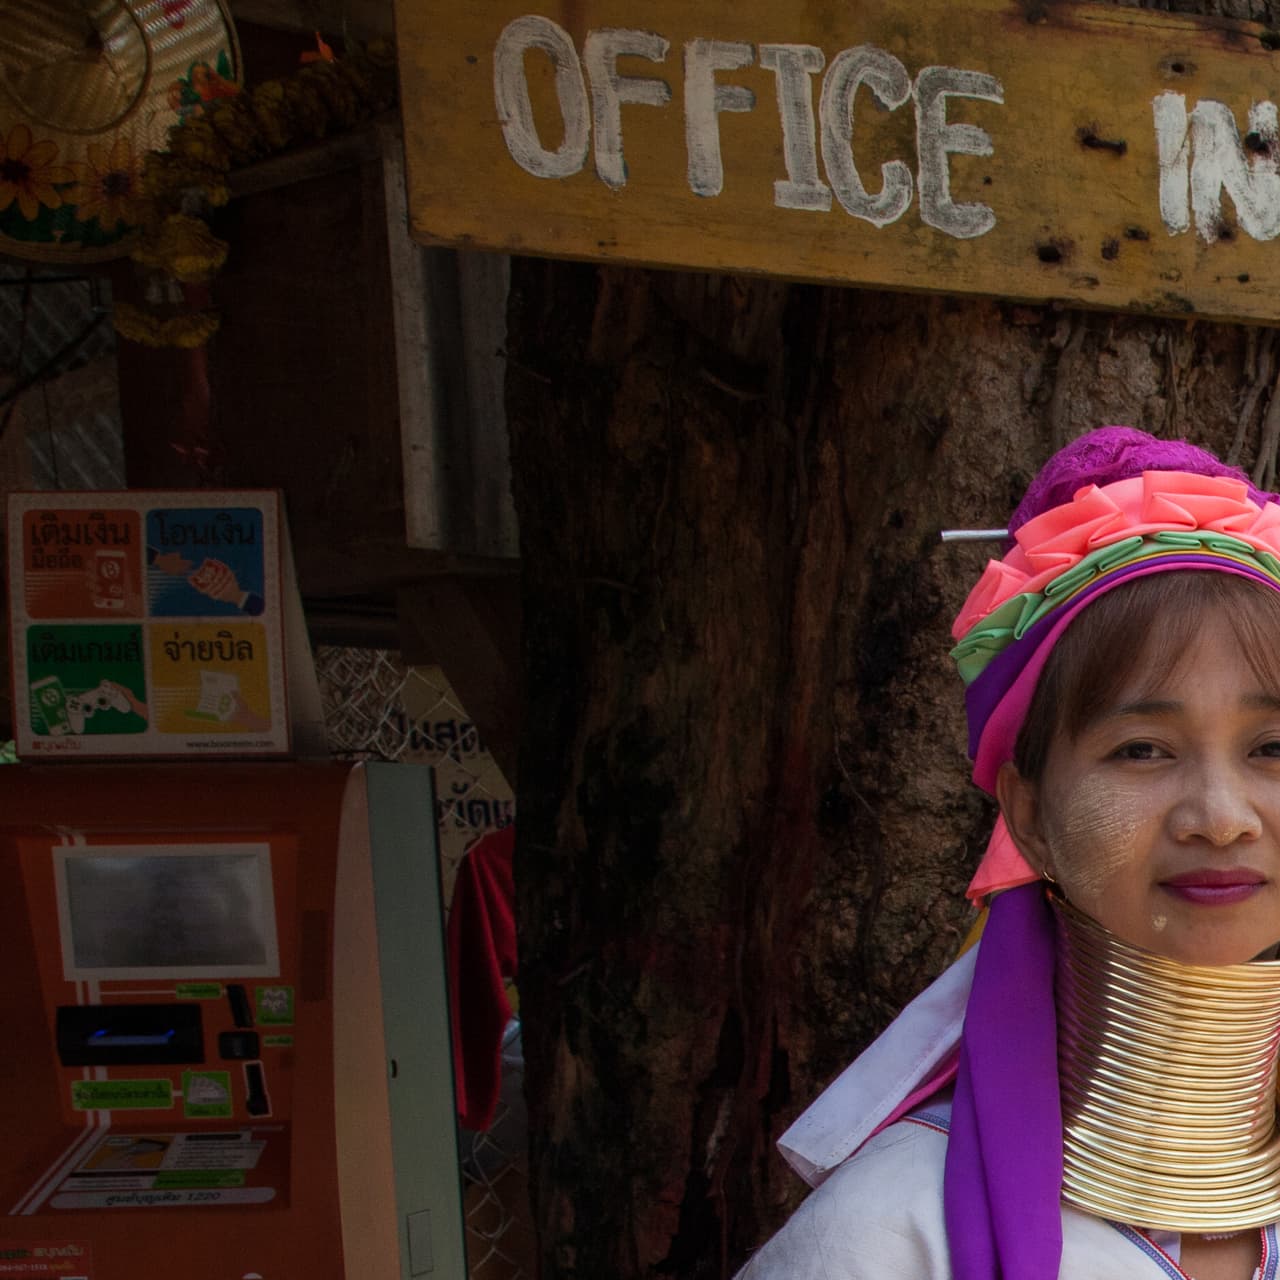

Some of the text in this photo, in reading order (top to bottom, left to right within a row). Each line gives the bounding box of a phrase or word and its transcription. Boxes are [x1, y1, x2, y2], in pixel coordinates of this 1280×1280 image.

[494, 14, 1004, 238] OFFICE
[30, 513, 130, 545] เติมเงิน
[153, 513, 256, 545] โอนเงิน
[163, 631, 254, 662] จ่ายบิล
